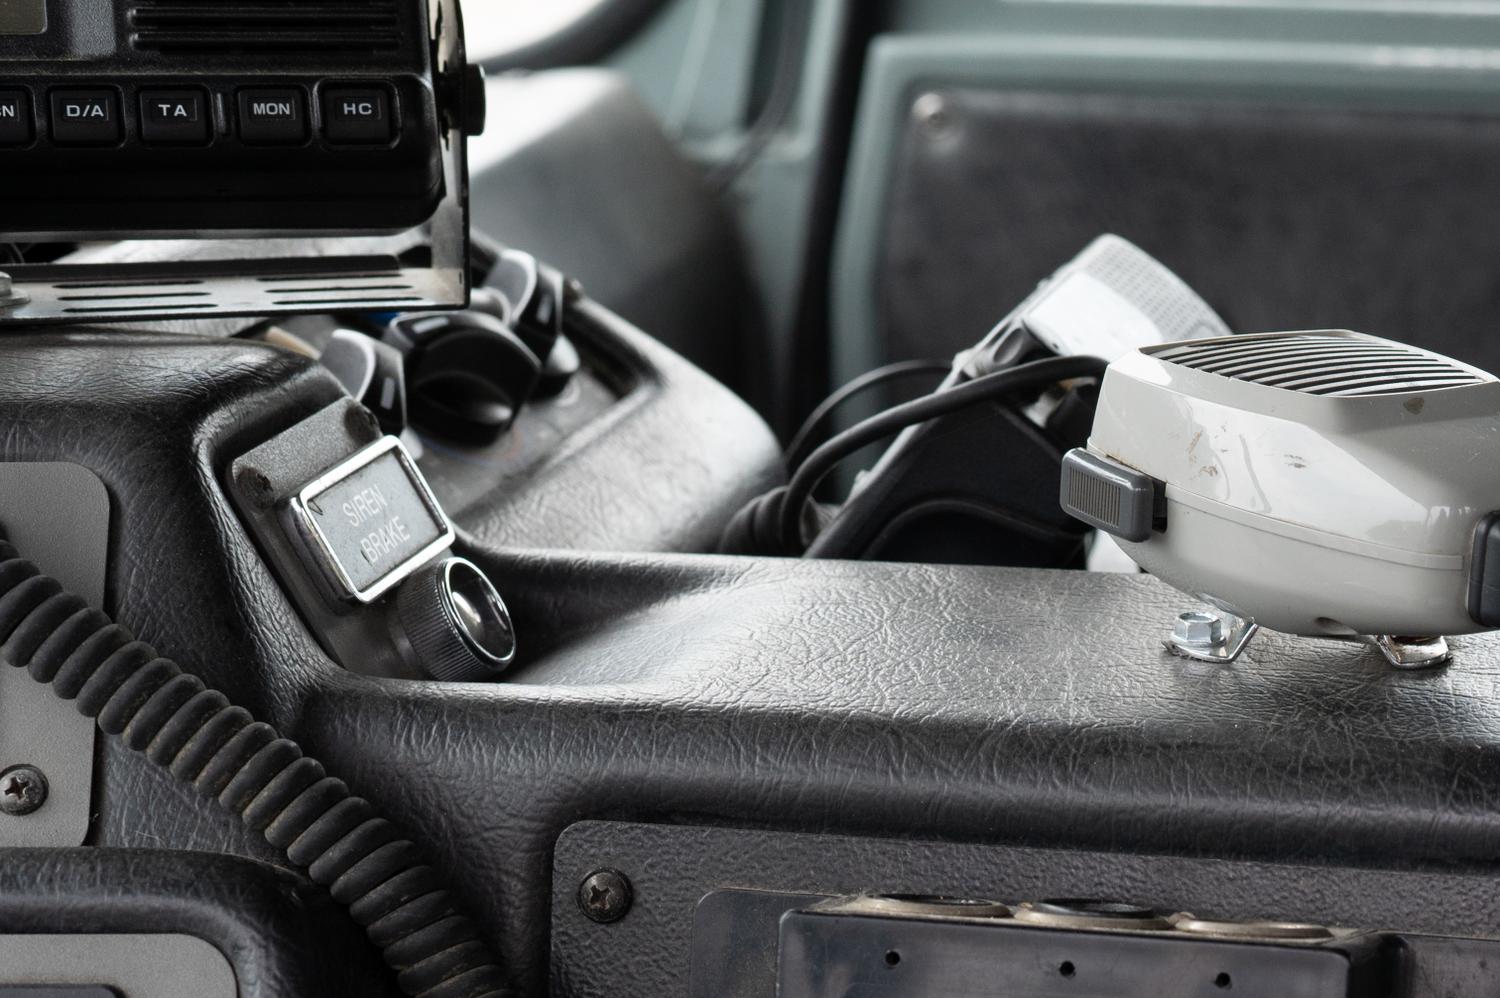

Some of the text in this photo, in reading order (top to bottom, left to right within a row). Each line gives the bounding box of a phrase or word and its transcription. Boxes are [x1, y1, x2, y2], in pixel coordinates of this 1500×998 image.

[0, 105, 15, 117] N
[66, 104, 104, 117] D/A
[158, 104, 188, 117] TA
[253, 103, 291, 115] MON
[343, 103, 373, 115] HC
[342, 483, 388, 527] SIREN
[360, 516, 411, 563] BRAKE
